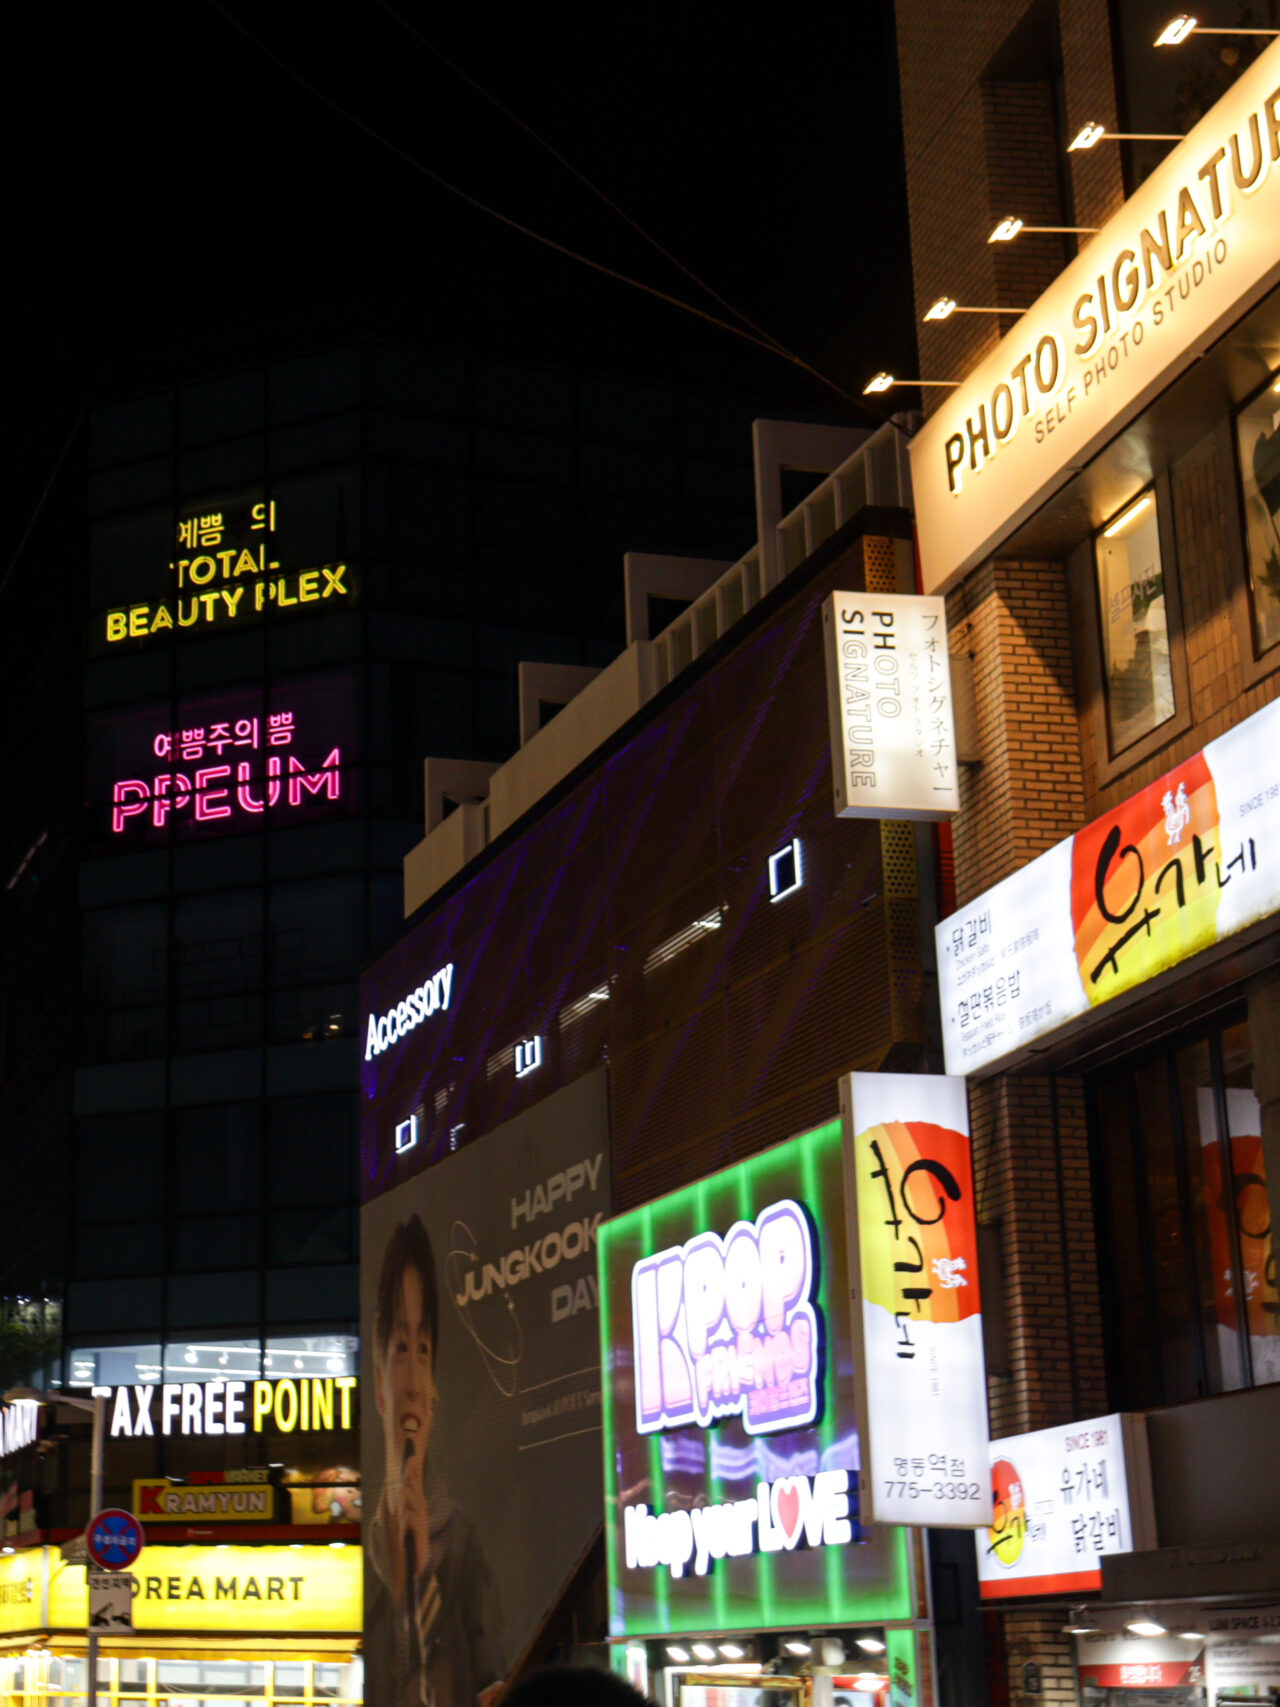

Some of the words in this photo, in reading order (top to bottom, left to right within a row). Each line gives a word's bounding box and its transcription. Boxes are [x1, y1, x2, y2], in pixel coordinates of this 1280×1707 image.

[1034, 388, 1077, 445] SELF
[1083, 320, 1145, 397] PHOTO
[1152, 238, 1227, 327] STUDIO
[944, 335, 1062, 492] PHOTO
[106, 586, 245, 643] BEAUTY
[254, 564, 348, 612] PLEX
[169, 542, 280, 589] TOTAL
[841, 608, 877, 788] SIGNATURE
[871, 611, 902, 719] PHOTO
[112, 747, 341, 832] PPEUM
[1264, 781, 1280, 804] 198
[952, 908, 992, 958] 닭갈비
[364, 962, 455, 1062] Accessory
[511, 1153, 603, 1230] HAPPY
[455, 1211, 603, 1307] JUNGKOOK
[161, 1380, 247, 1437] FREE
[253, 1376, 357, 1434] POINT
[165, 1491, 267, 1514] RAMYUN
[883, 1481, 982, 1501] 775-3392
[893, 1453, 966, 1478] 명동역점
[756, 1468, 853, 1553] LOVE
[1071, 1507, 1124, 1554] 닭갈비
[131, 1576, 206, 1601] OREA
[214, 1575, 305, 1601] MART
